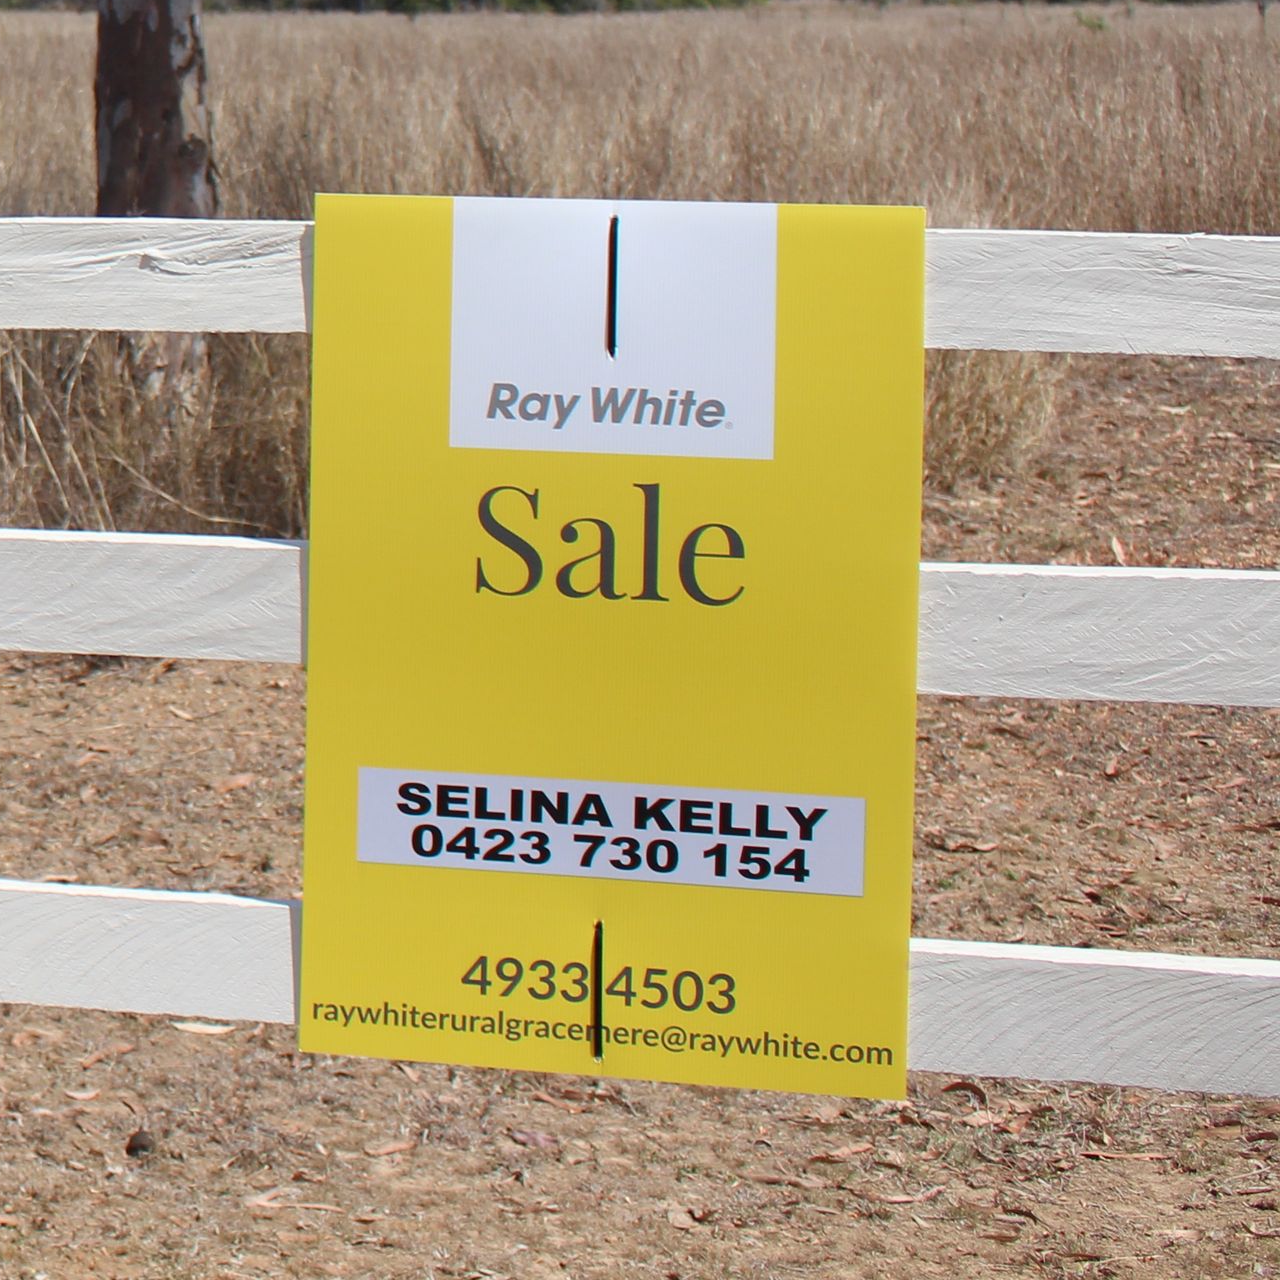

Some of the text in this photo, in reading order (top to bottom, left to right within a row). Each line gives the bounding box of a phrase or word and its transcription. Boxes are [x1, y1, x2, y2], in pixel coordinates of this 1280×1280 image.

[486, 382, 726, 430] Ray White
[475, 482, 746, 607] Sale
[396, 781, 828, 842] SELINA KELLY
[410, 823, 811, 884] 0423 730 154
[460, 955, 737, 1015] 4933 4503
